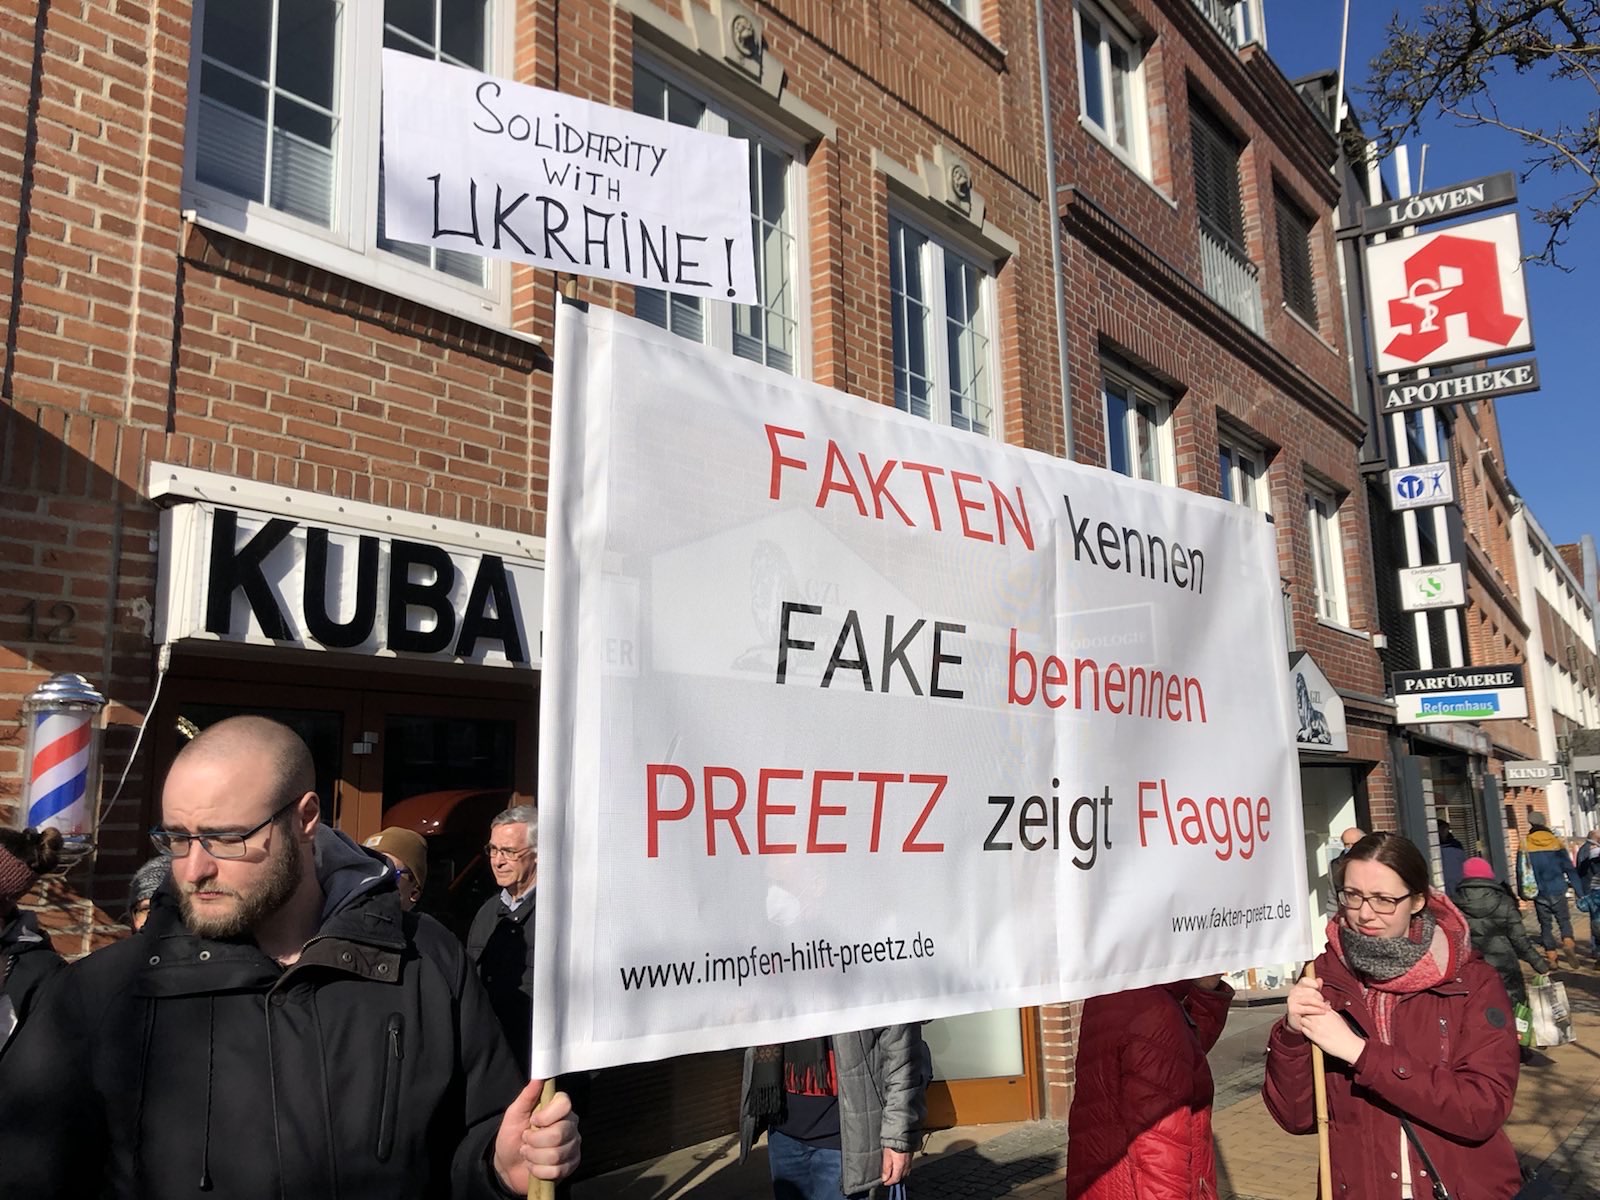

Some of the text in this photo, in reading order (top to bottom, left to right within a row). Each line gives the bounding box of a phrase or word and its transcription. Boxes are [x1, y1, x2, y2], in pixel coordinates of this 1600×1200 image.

[1389, 184, 1485, 225] LÖWEN
[1385, 365, 1534, 409] APOTHEKE
[764, 424, 1205, 595] FAKTEN kennen
[206, 508, 524, 663] KUBA
[16, 599, 77, 645] 12
[776, 601, 1208, 724] FAKE benennen
[1405, 672, 1515, 691] PARFÜMERIE
[1423, 700, 1494, 715] Reformhaus
[1508, 767, 1548, 779] KIND
[646, 764, 1272, 870] PREETZ zeigt Flagge
[1171, 899, 1291, 933] www.fakten-preetz.de
[620, 931, 936, 991] www.impfen-hilft-preetz.de
